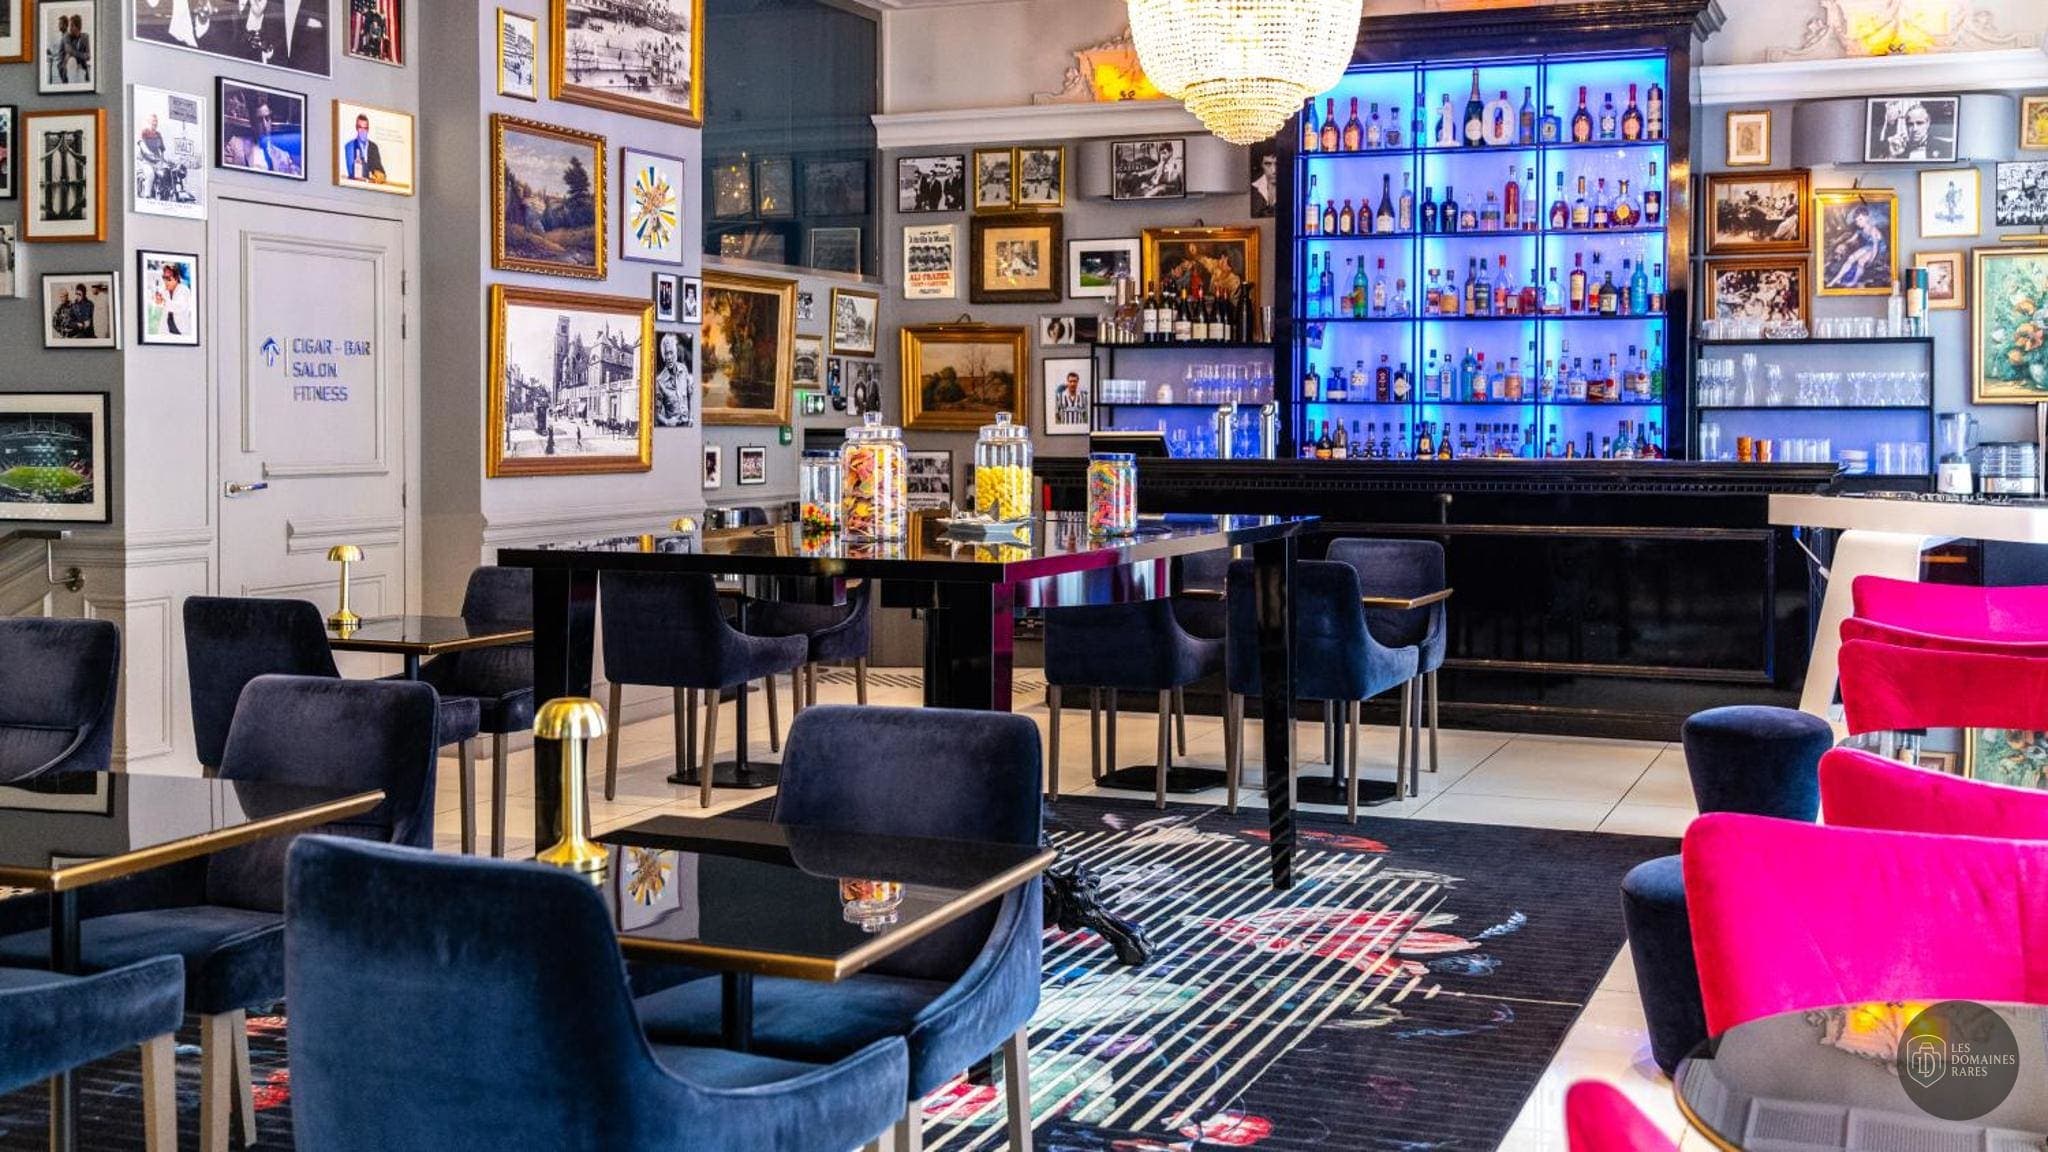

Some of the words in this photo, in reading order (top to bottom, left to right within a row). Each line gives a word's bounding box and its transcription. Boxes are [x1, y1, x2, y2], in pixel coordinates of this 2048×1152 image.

[293, 338, 332, 355] CIGAR
[344, 340, 371, 356] BAR
[293, 362, 337, 377] SALON
[293, 386, 348, 401] FITNESS
